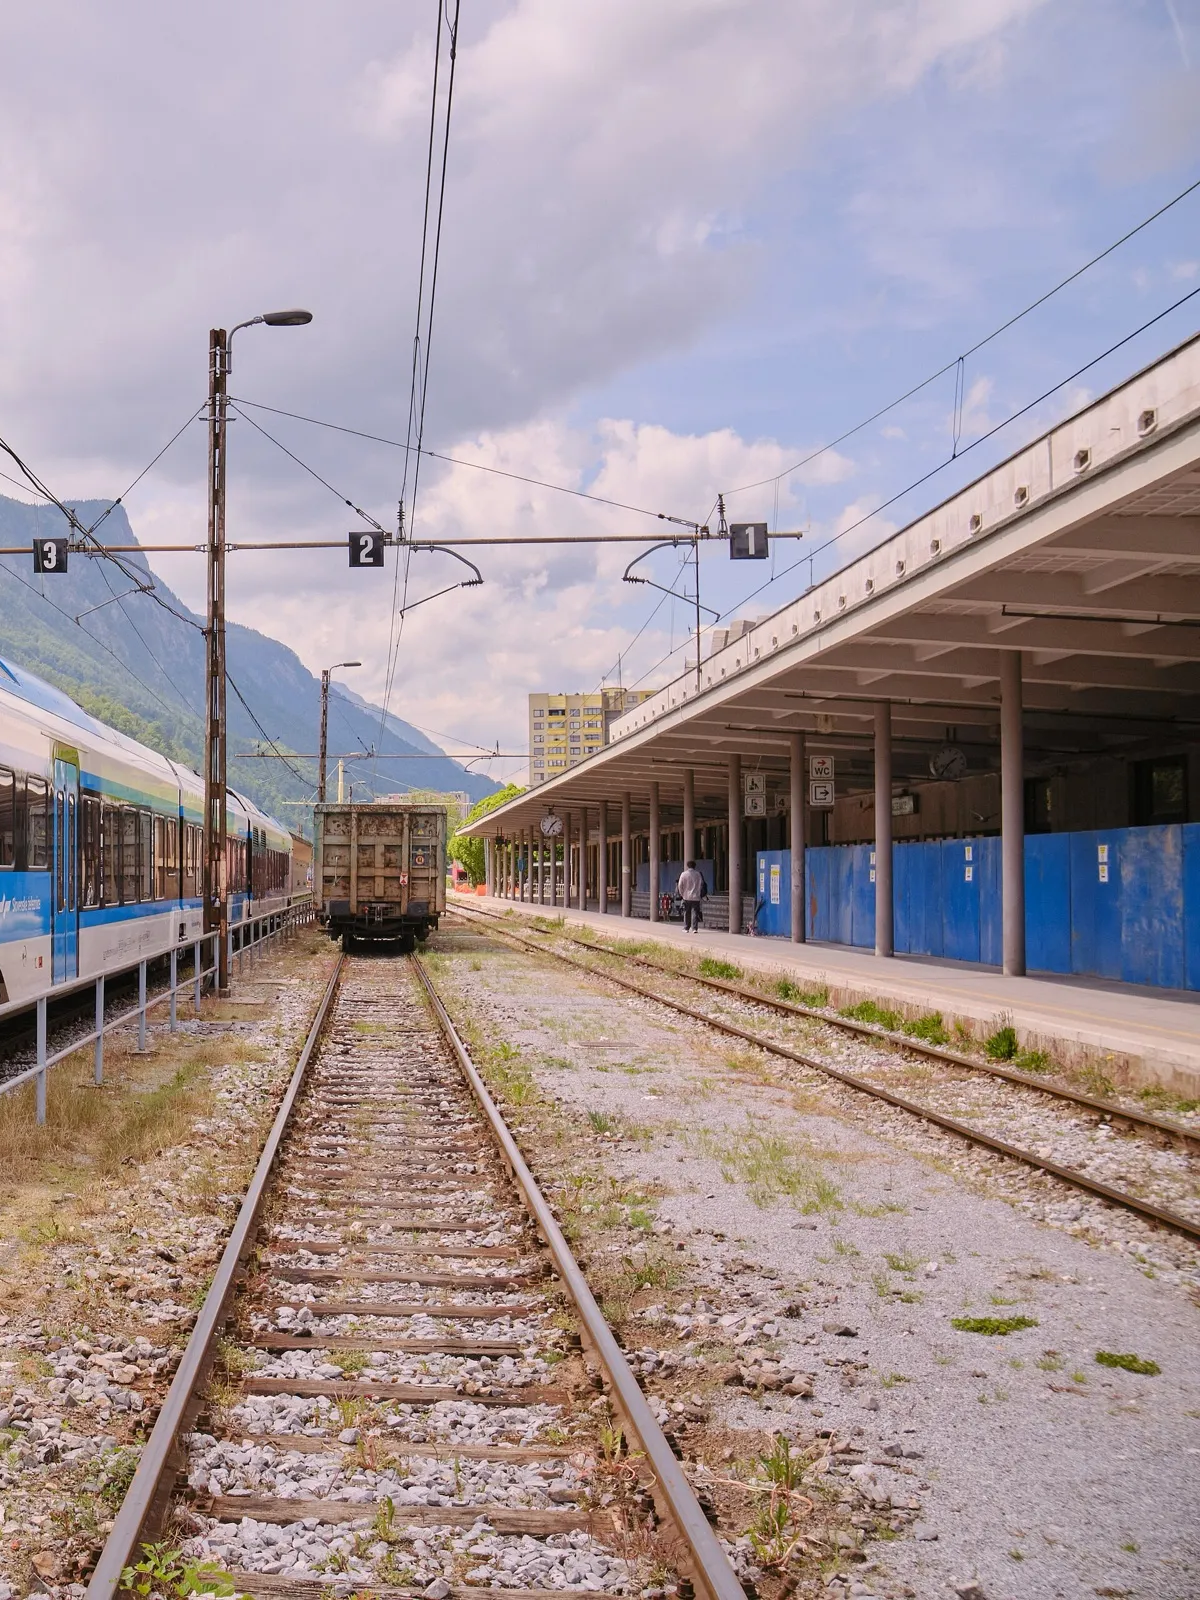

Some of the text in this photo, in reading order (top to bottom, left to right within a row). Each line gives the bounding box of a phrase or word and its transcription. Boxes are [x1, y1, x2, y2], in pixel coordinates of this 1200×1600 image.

[359, 535, 374, 563] 2
[745, 526, 755, 555] 1
[43, 541, 57, 569] 3
[814, 767, 830, 776] WC
